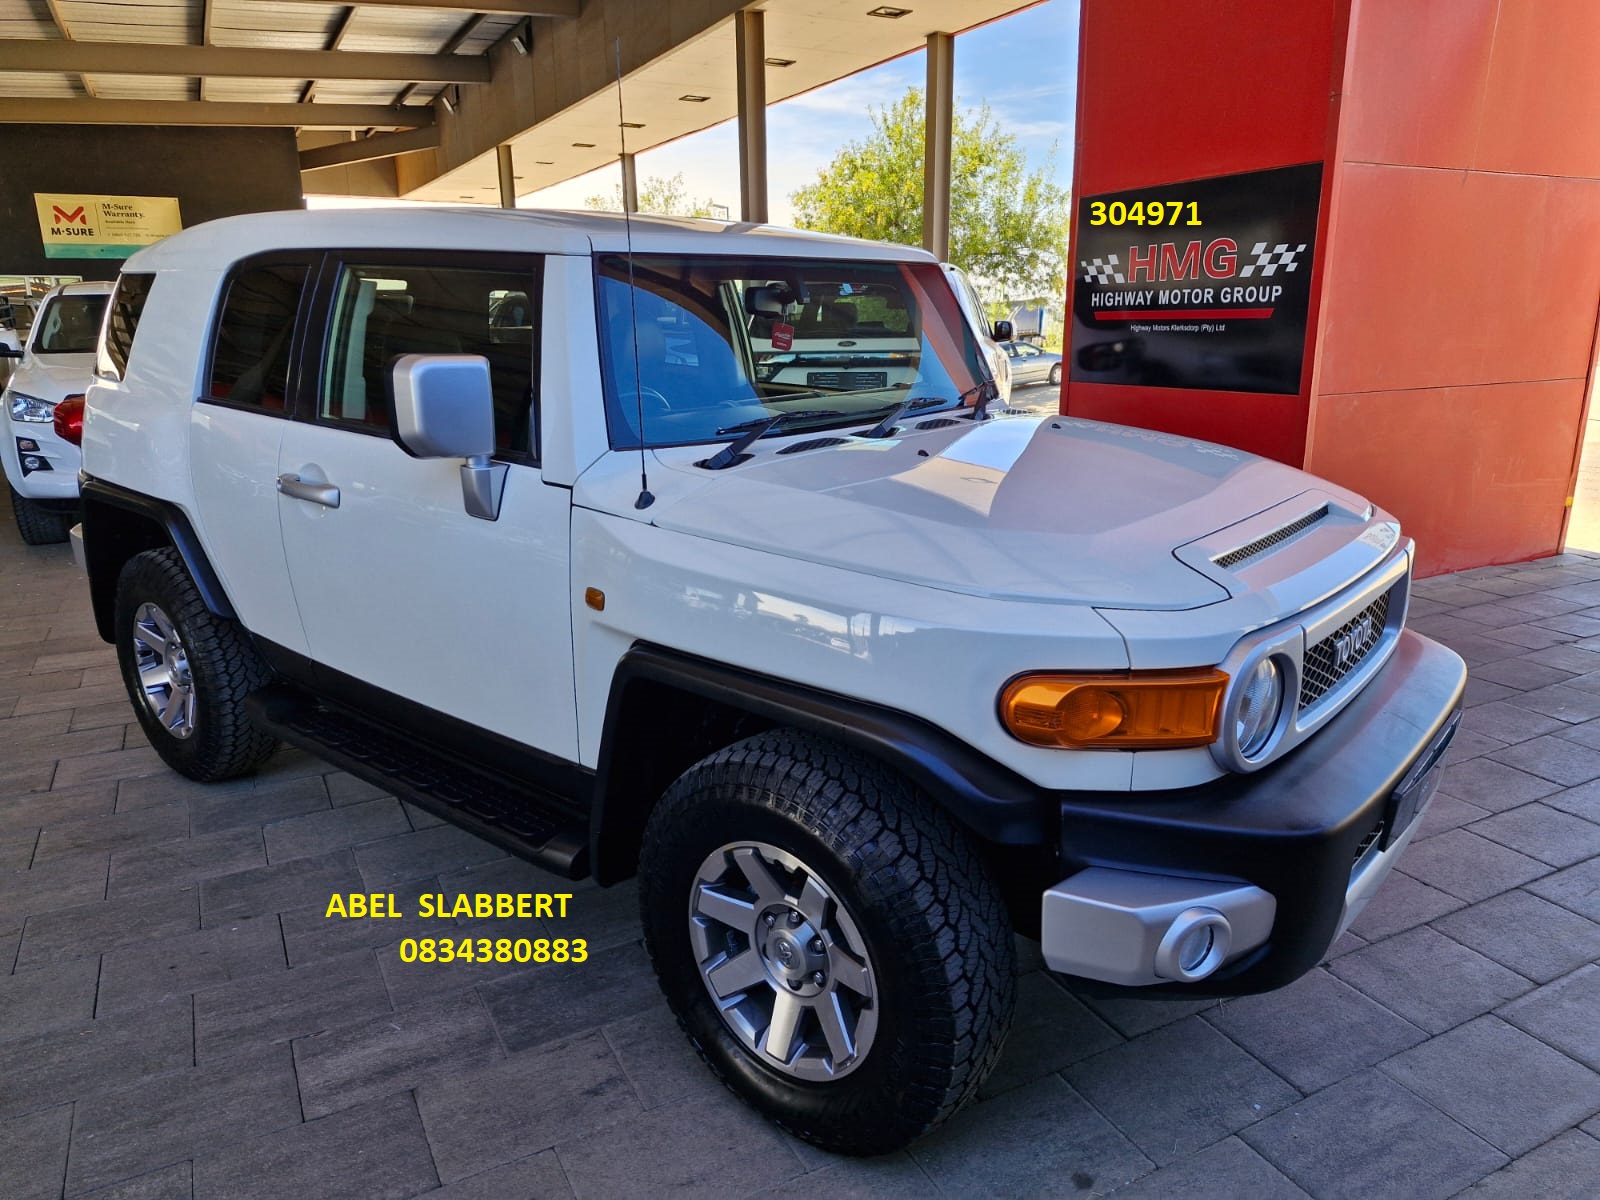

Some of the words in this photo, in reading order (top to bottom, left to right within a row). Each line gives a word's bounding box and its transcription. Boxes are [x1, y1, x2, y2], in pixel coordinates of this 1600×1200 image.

[1127, 237, 1238, 283] HMG
[1091, 290, 1154, 307] HIGHWAY
[1158, 287, 1214, 305] MOTOR
[1220, 285, 1283, 304] GROUP
[1200, 323, 1215, 333] (Pty)
[1215, 324, 1226, 332] Ltd
